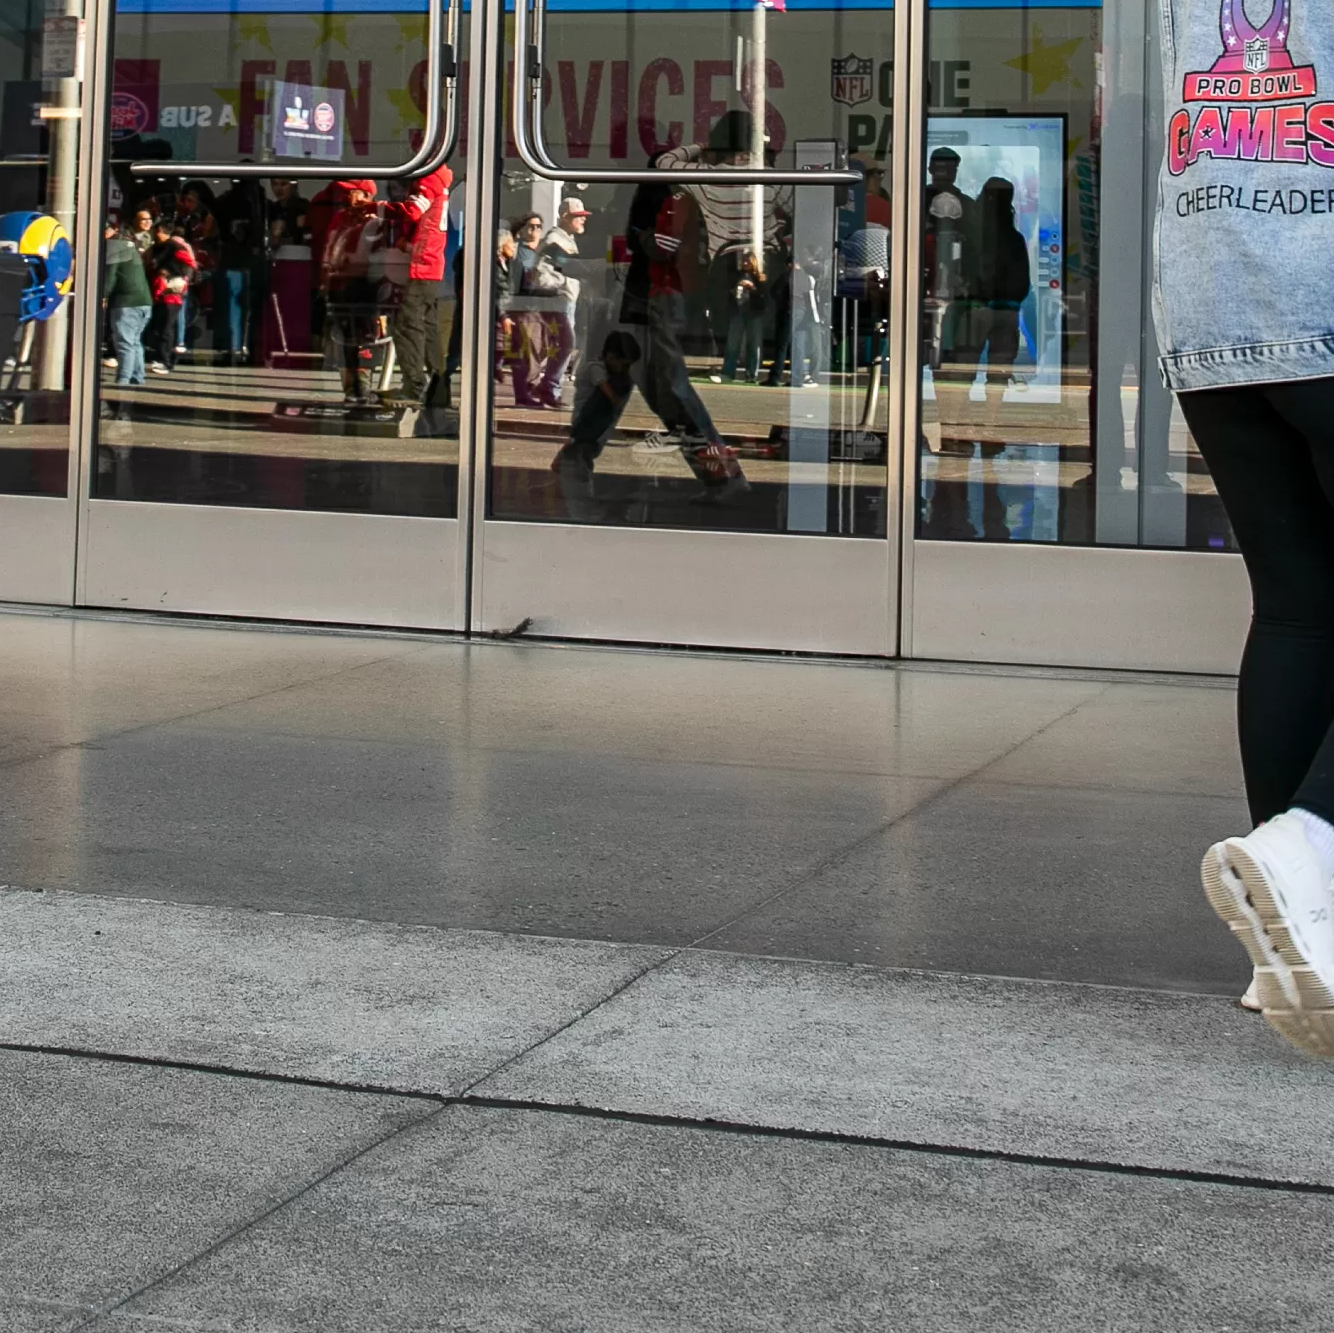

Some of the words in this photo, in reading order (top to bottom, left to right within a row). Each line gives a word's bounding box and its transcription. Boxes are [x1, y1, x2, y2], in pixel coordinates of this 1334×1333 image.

[1246, 51, 1266, 68] NFL
[834, 76, 869, 101] NFL
[1195, 77, 1242, 97] PRO
[1248, 73, 1303, 96] BOWL
[238, 59, 372, 156] FAN
